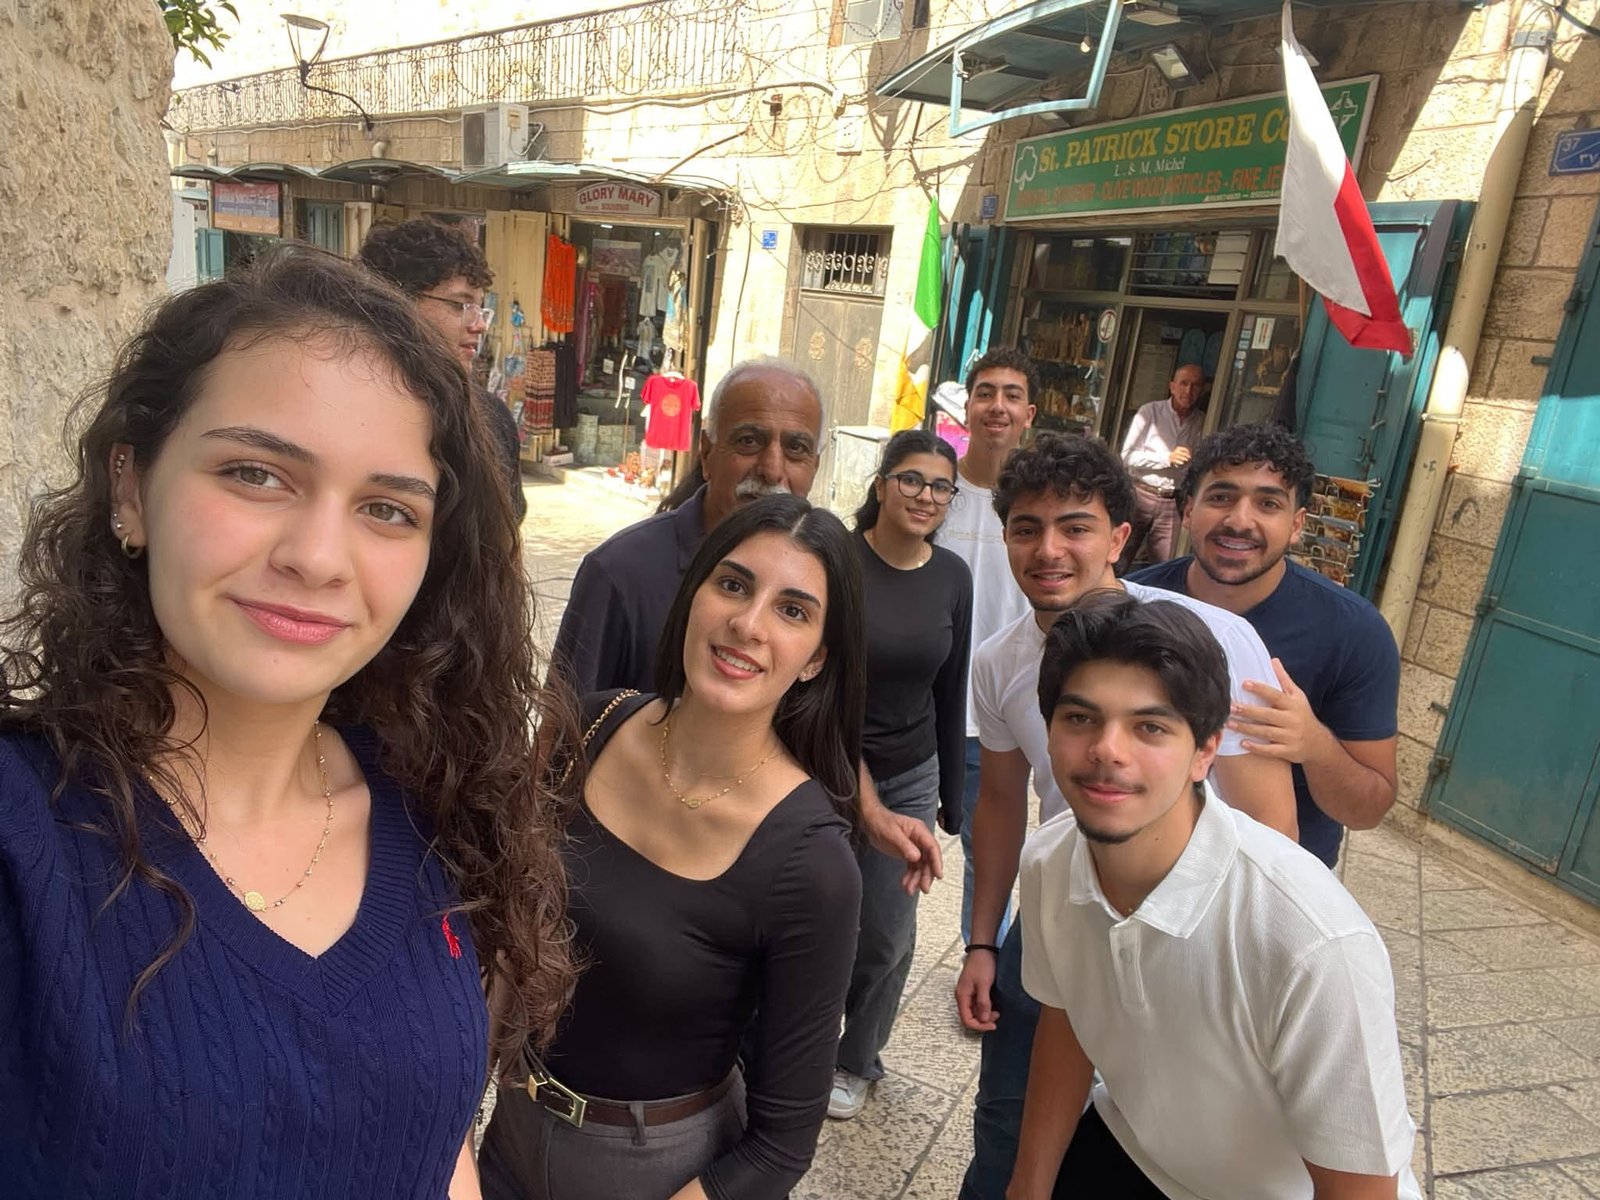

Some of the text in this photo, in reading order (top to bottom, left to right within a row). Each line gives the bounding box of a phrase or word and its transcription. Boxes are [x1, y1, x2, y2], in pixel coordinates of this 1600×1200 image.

[1039, 146, 1060, 173] St.
[1064, 127, 1161, 168] PATRICK
[1163, 113, 1257, 155] STORE
[1562, 137, 1581, 152] 37
[1132, 176, 1165, 198] WOOD
[1165, 170, 1223, 194] ARTICLES
[1231, 167, 1262, 191] FINE
[1263, 165, 1284, 190] JE
[579, 186, 615, 205] GLORY
[618, 186, 655, 208] MARY
